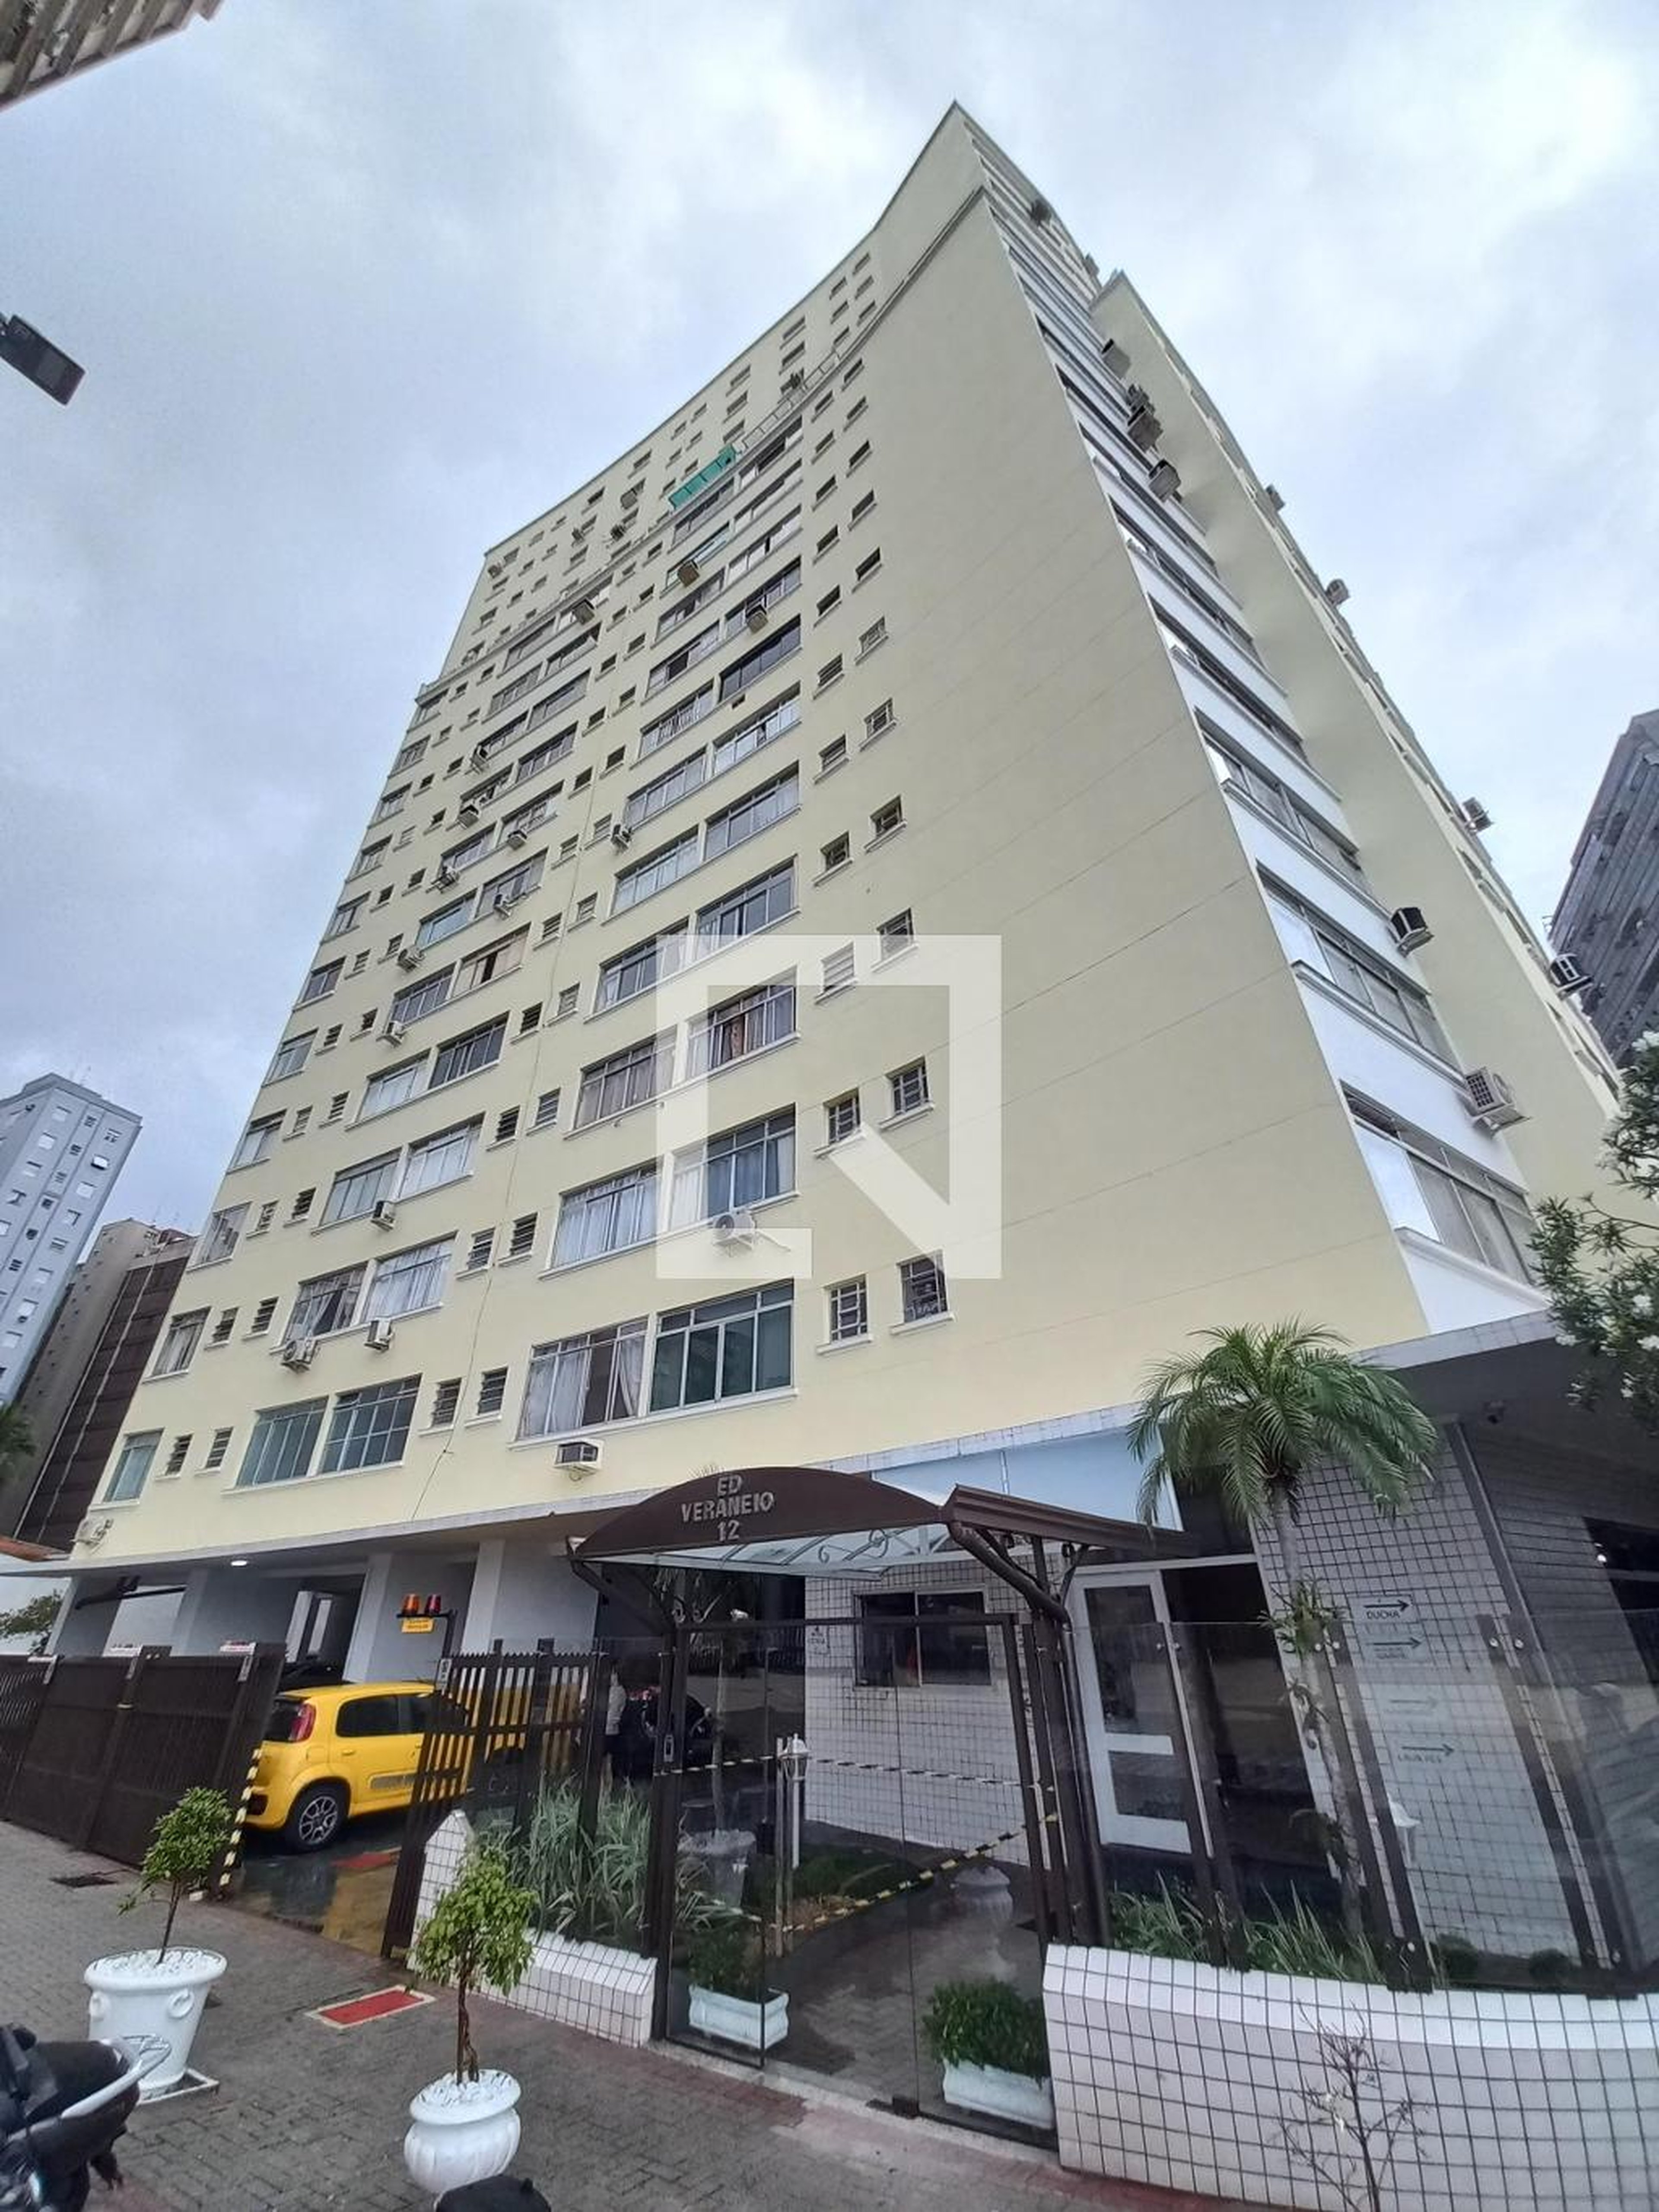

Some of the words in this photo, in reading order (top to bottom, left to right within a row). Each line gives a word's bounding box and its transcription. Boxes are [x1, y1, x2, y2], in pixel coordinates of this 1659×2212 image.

[717, 1474, 742, 1496] ED
[681, 1492, 774, 1522] VERANEIO
[717, 1519, 740, 1541] 12
